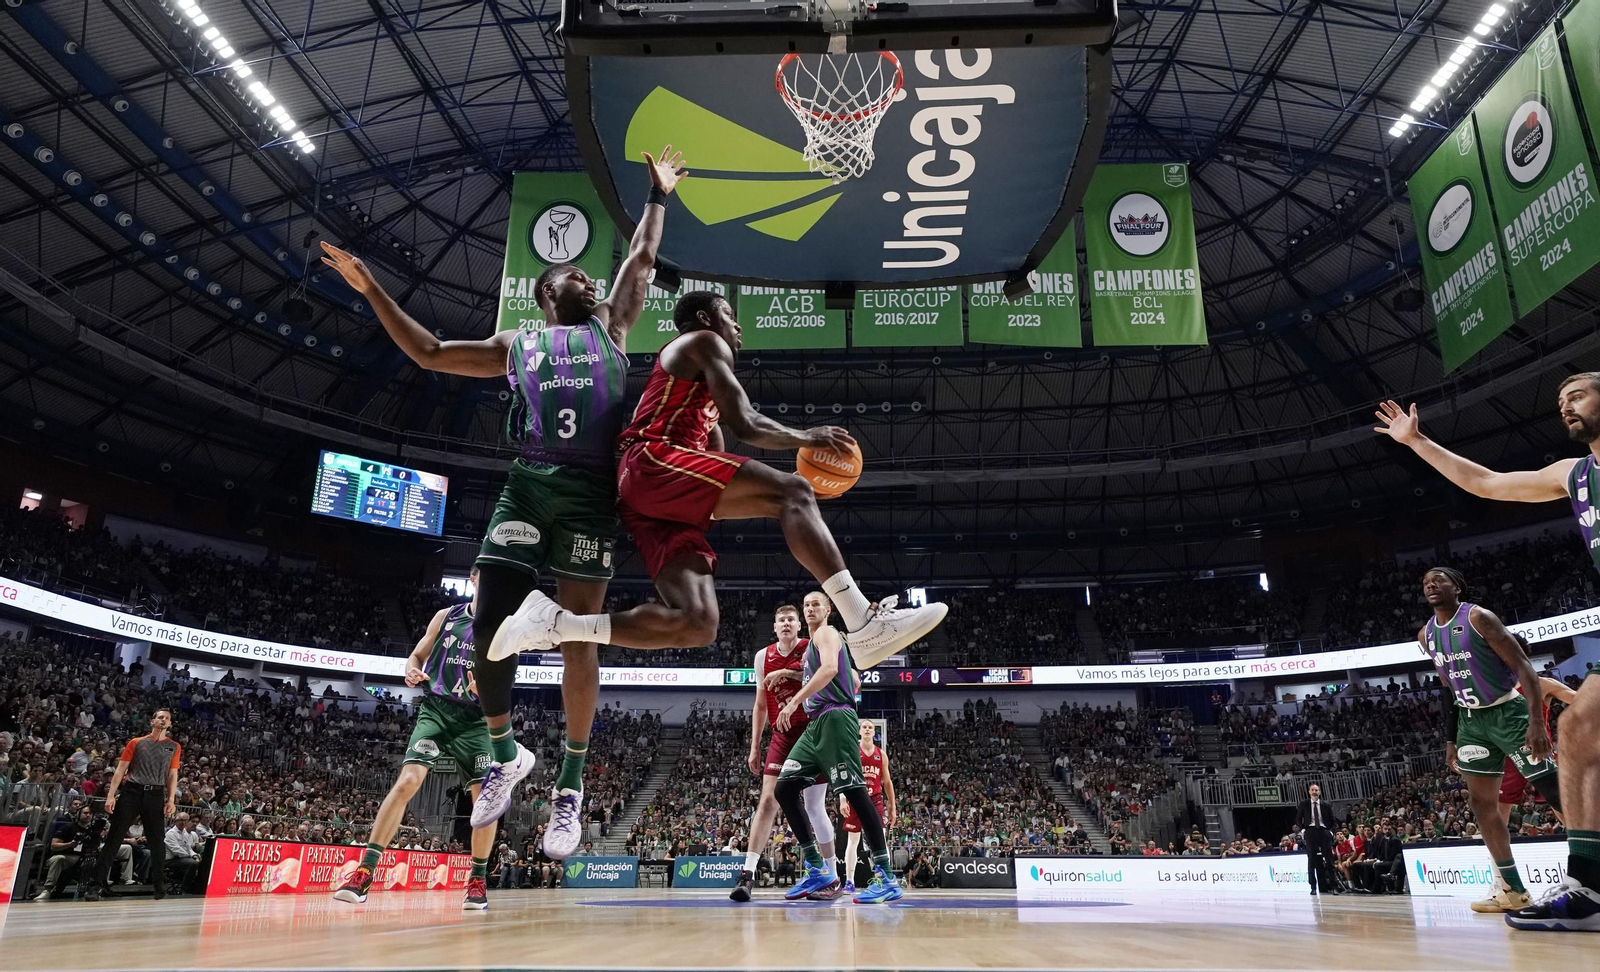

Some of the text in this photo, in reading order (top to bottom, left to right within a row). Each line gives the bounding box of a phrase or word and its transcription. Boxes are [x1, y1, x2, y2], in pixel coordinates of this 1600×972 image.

[883, 48, 1016, 268] Unicaja
[1504, 162, 1588, 252] CAMPEONES
[1510, 190, 1595, 267] SUPERCOPA
[1539, 237, 1572, 272] 2024
[1094, 269, 1196, 291] CAMPEONES
[1431, 241, 1497, 315] CAMPEONES
[768, 296, 814, 313] ACB
[863, 293, 951, 308] EUROCUP
[971, 295, 1010, 307] COPA
[1048, 295, 1077, 307] REY
[1133, 297, 1162, 308] BCL
[1463, 298, 1473, 310] CUP
[756, 315, 826, 328] 2005/2006
[874, 312, 939, 325] 2016/2017
[1008, 314, 1041, 327] 2023
[1131, 312, 1166, 325] 2024
[1460, 307, 1485, 336] 2024
[548, 351, 600, 366] Unicaja
[557, 408, 577, 439] 3
[366, 464, 374, 472] 4
[812, 450, 855, 474] Wilson
[399, 471, 406, 480] 0
[374, 489, 396, 501] 7:26
[571, 544, 598, 561] laga
[1538, 621, 1568, 640] para
[111, 614, 355, 668] Vamos más lejos para estar más cerca
[525, 667, 553, 682] lejos
[620, 669, 644, 682] más
[647, 671, 678, 682] cerca
[898, 672, 913, 682] 15
[930, 669, 940, 684] 0
[1077, 659, 1316, 681] Vamos más lejos para estar más cerca
[982, 675, 1009, 684] MURCIA
[451, 678, 464, 698] 4
[230, 842, 282, 862] PATATAS
[307, 846, 345, 864] PATATAS
[411, 853, 438, 867] PATATAS
[586, 862, 633, 871] Fundación
[699, 861, 744, 871] Fundación
[944, 860, 1008, 875] endesa
[233, 864, 272, 883] ARIZA
[309, 866, 337, 883] ARIZA
[413, 869, 432, 883] ARIZA
[586, 870, 619, 881] Unicaja
[699, 870, 732, 880] Unicaja
[1043, 867, 1122, 885] quirónsalud
[1157, 870, 1171, 882] La
[1175, 869, 1208, 882] salud
[1427, 864, 1494, 890] quirónsalud
[1525, 863, 1542, 884] La
